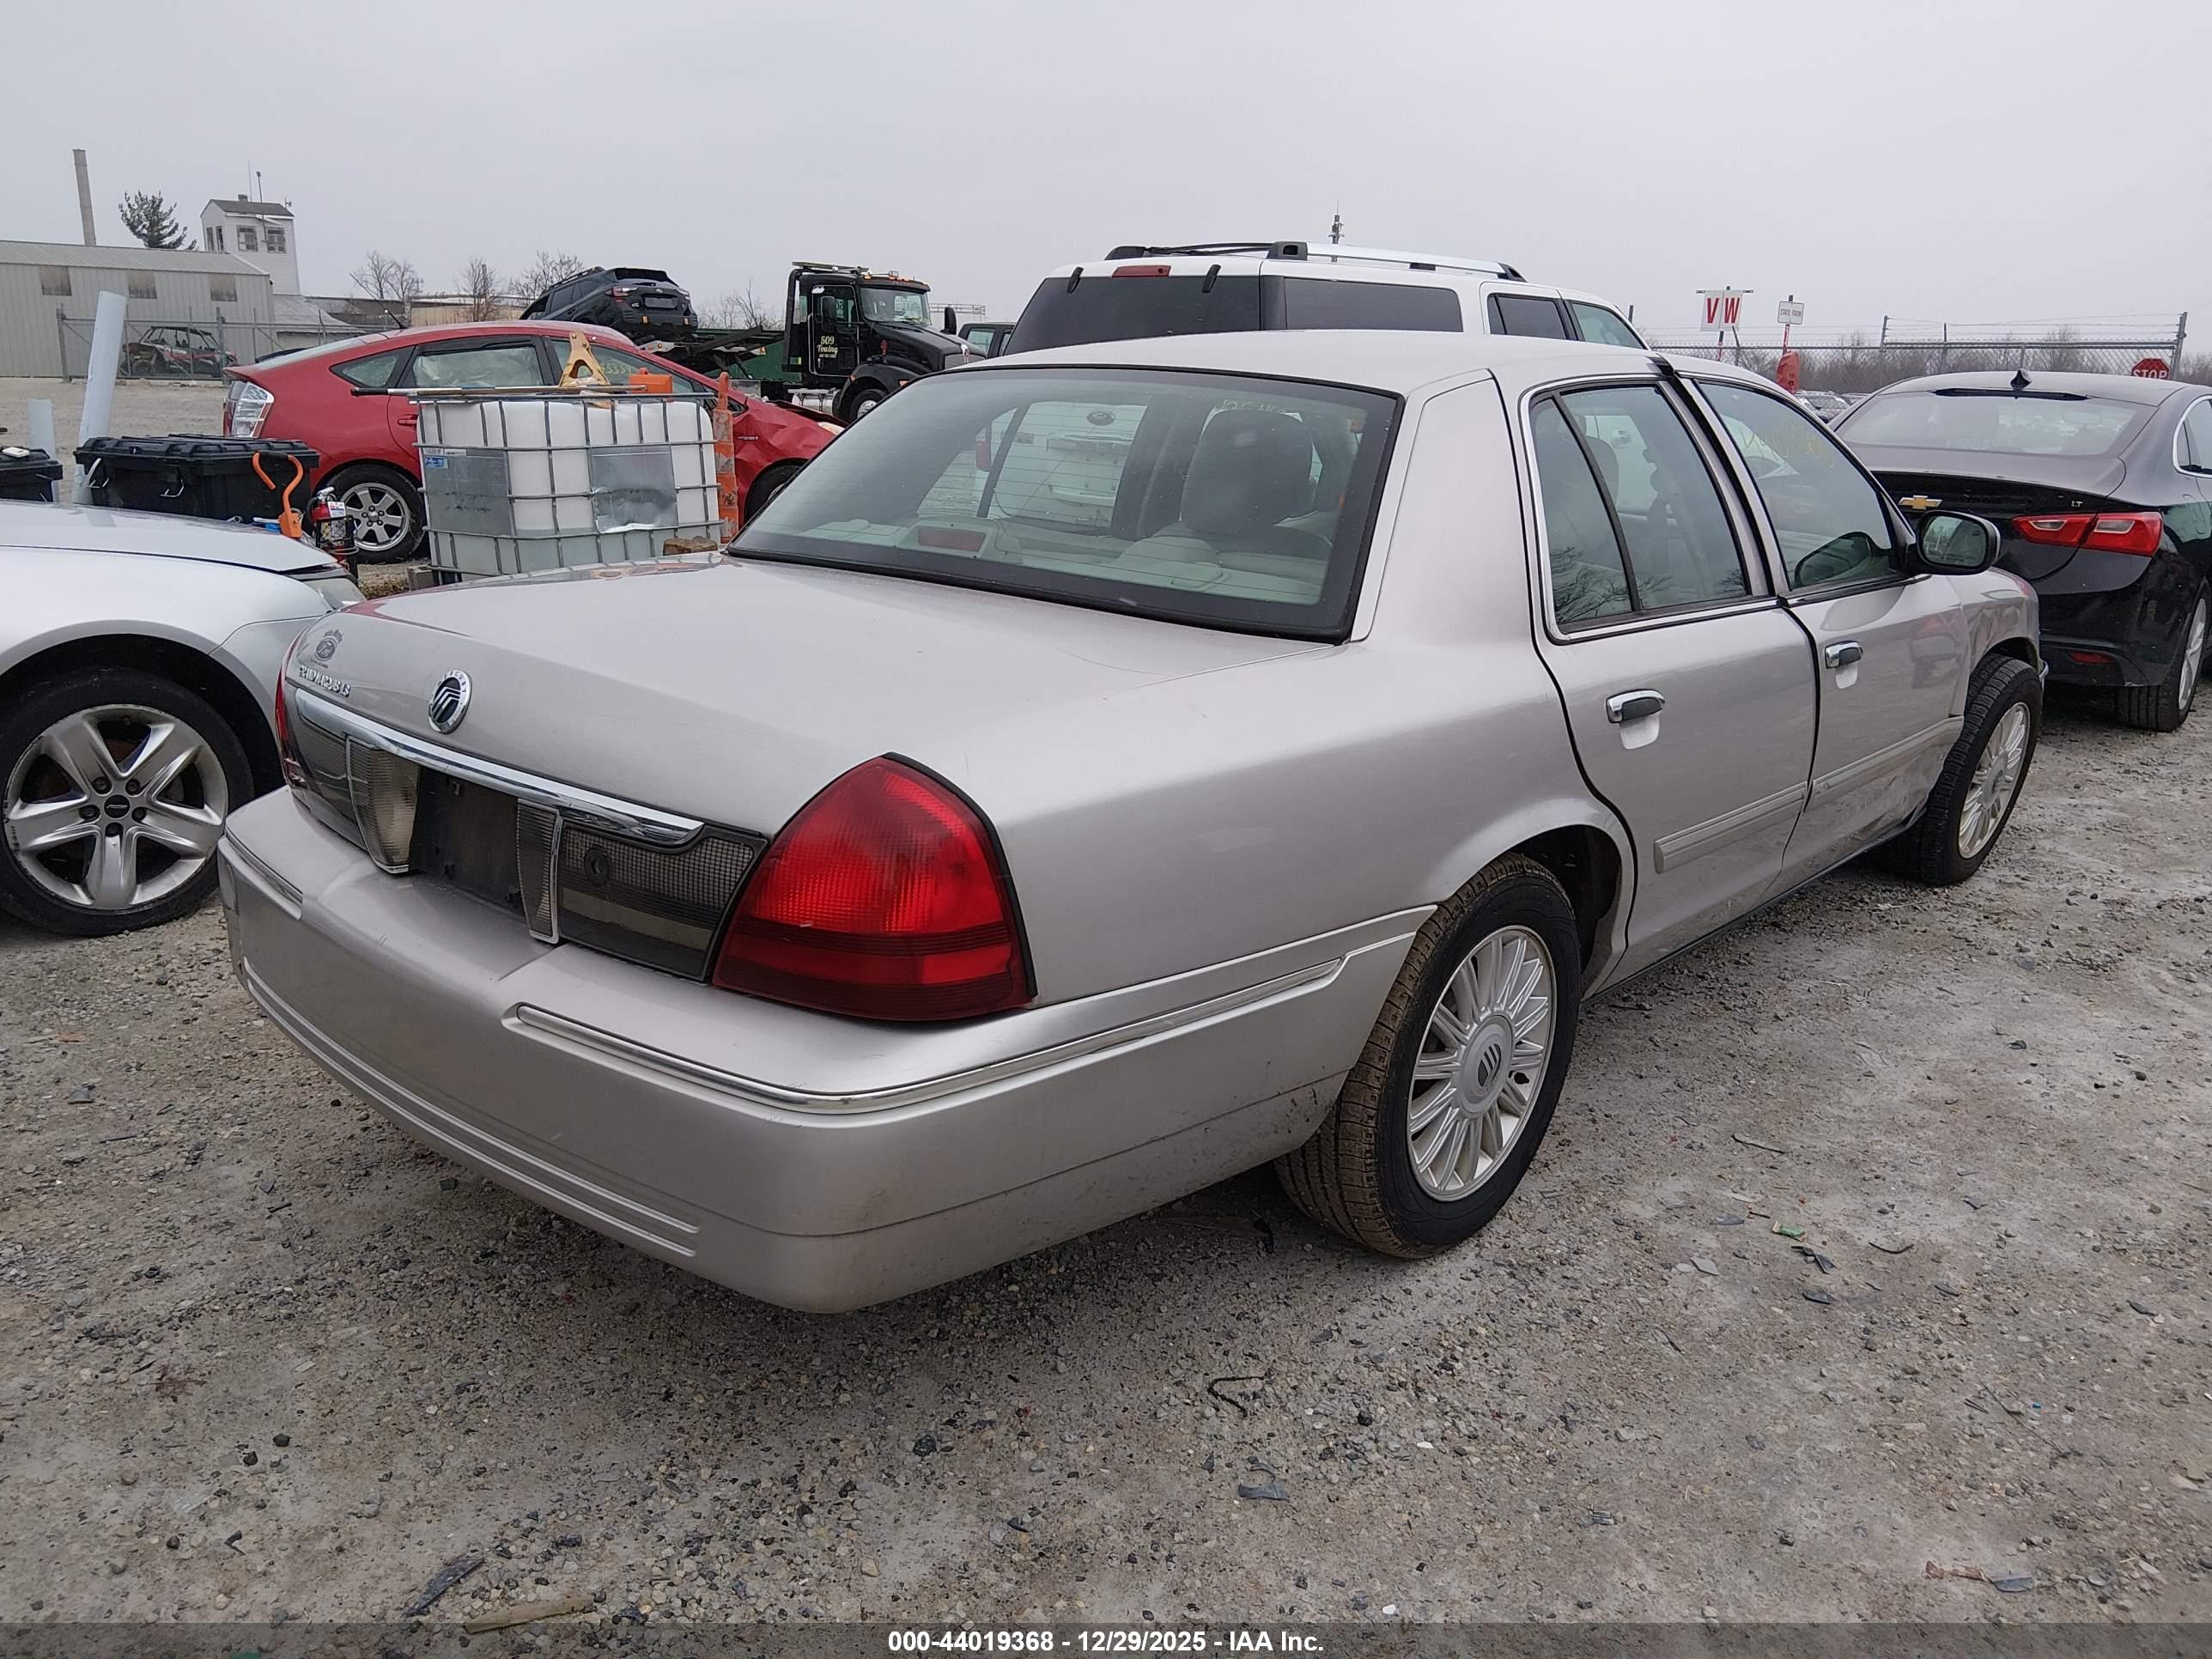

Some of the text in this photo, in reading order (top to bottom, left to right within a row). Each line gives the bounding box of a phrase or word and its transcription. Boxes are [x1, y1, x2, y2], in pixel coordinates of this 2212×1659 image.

[820, 336, 835, 344] 509
[817, 344, 838, 356] Towing
[2133, 369, 2167, 380] STOP
